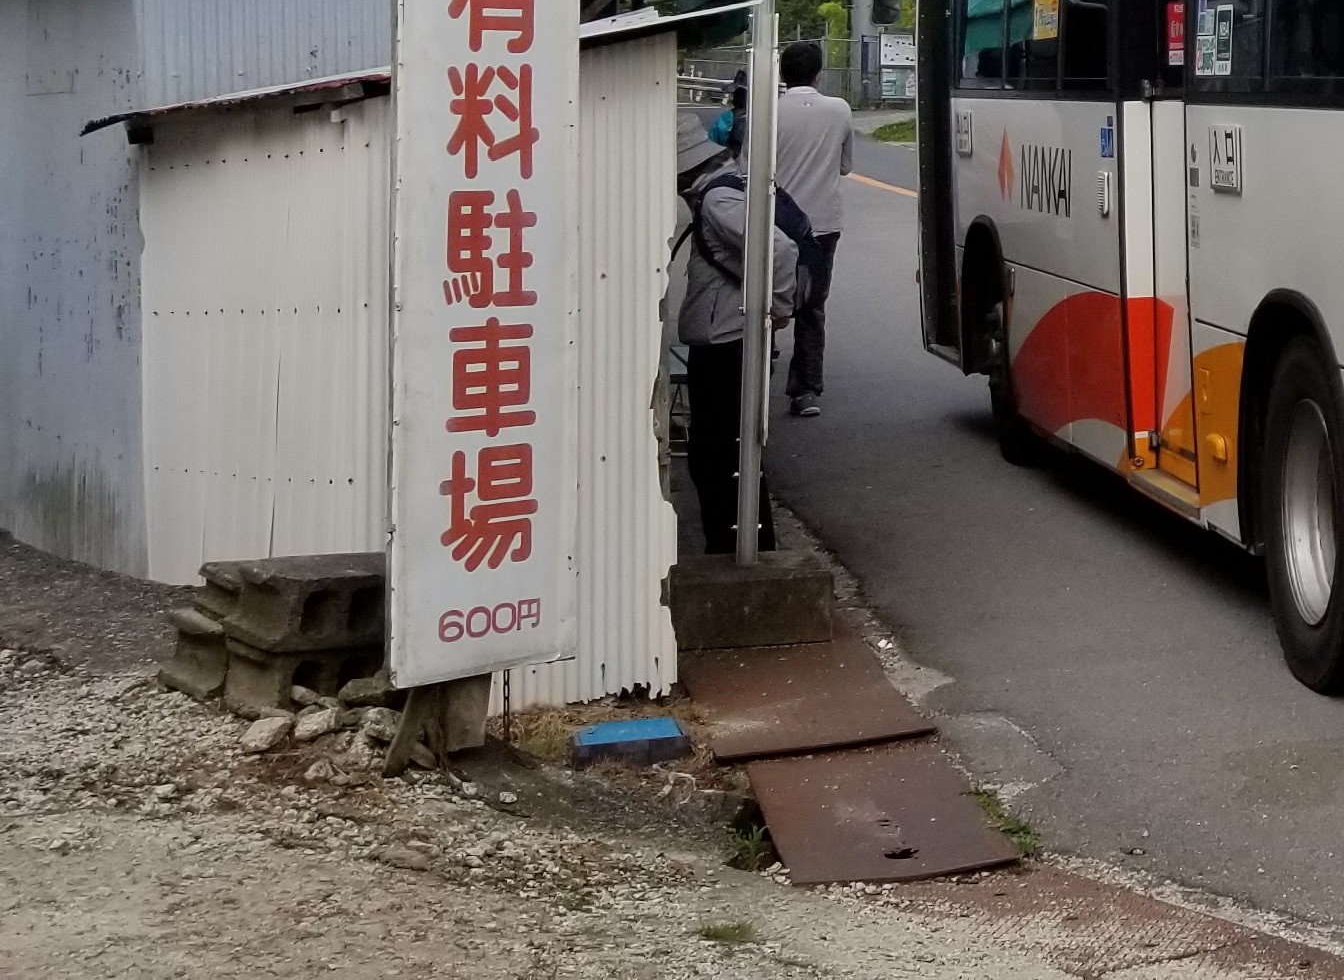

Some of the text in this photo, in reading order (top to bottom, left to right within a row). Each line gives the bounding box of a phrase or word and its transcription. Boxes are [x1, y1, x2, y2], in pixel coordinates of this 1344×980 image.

[1212, 129, 1235, 165] 入口
[1020, 143, 1073, 218] NANKAI
[438, 597, 542, 642] 600円
